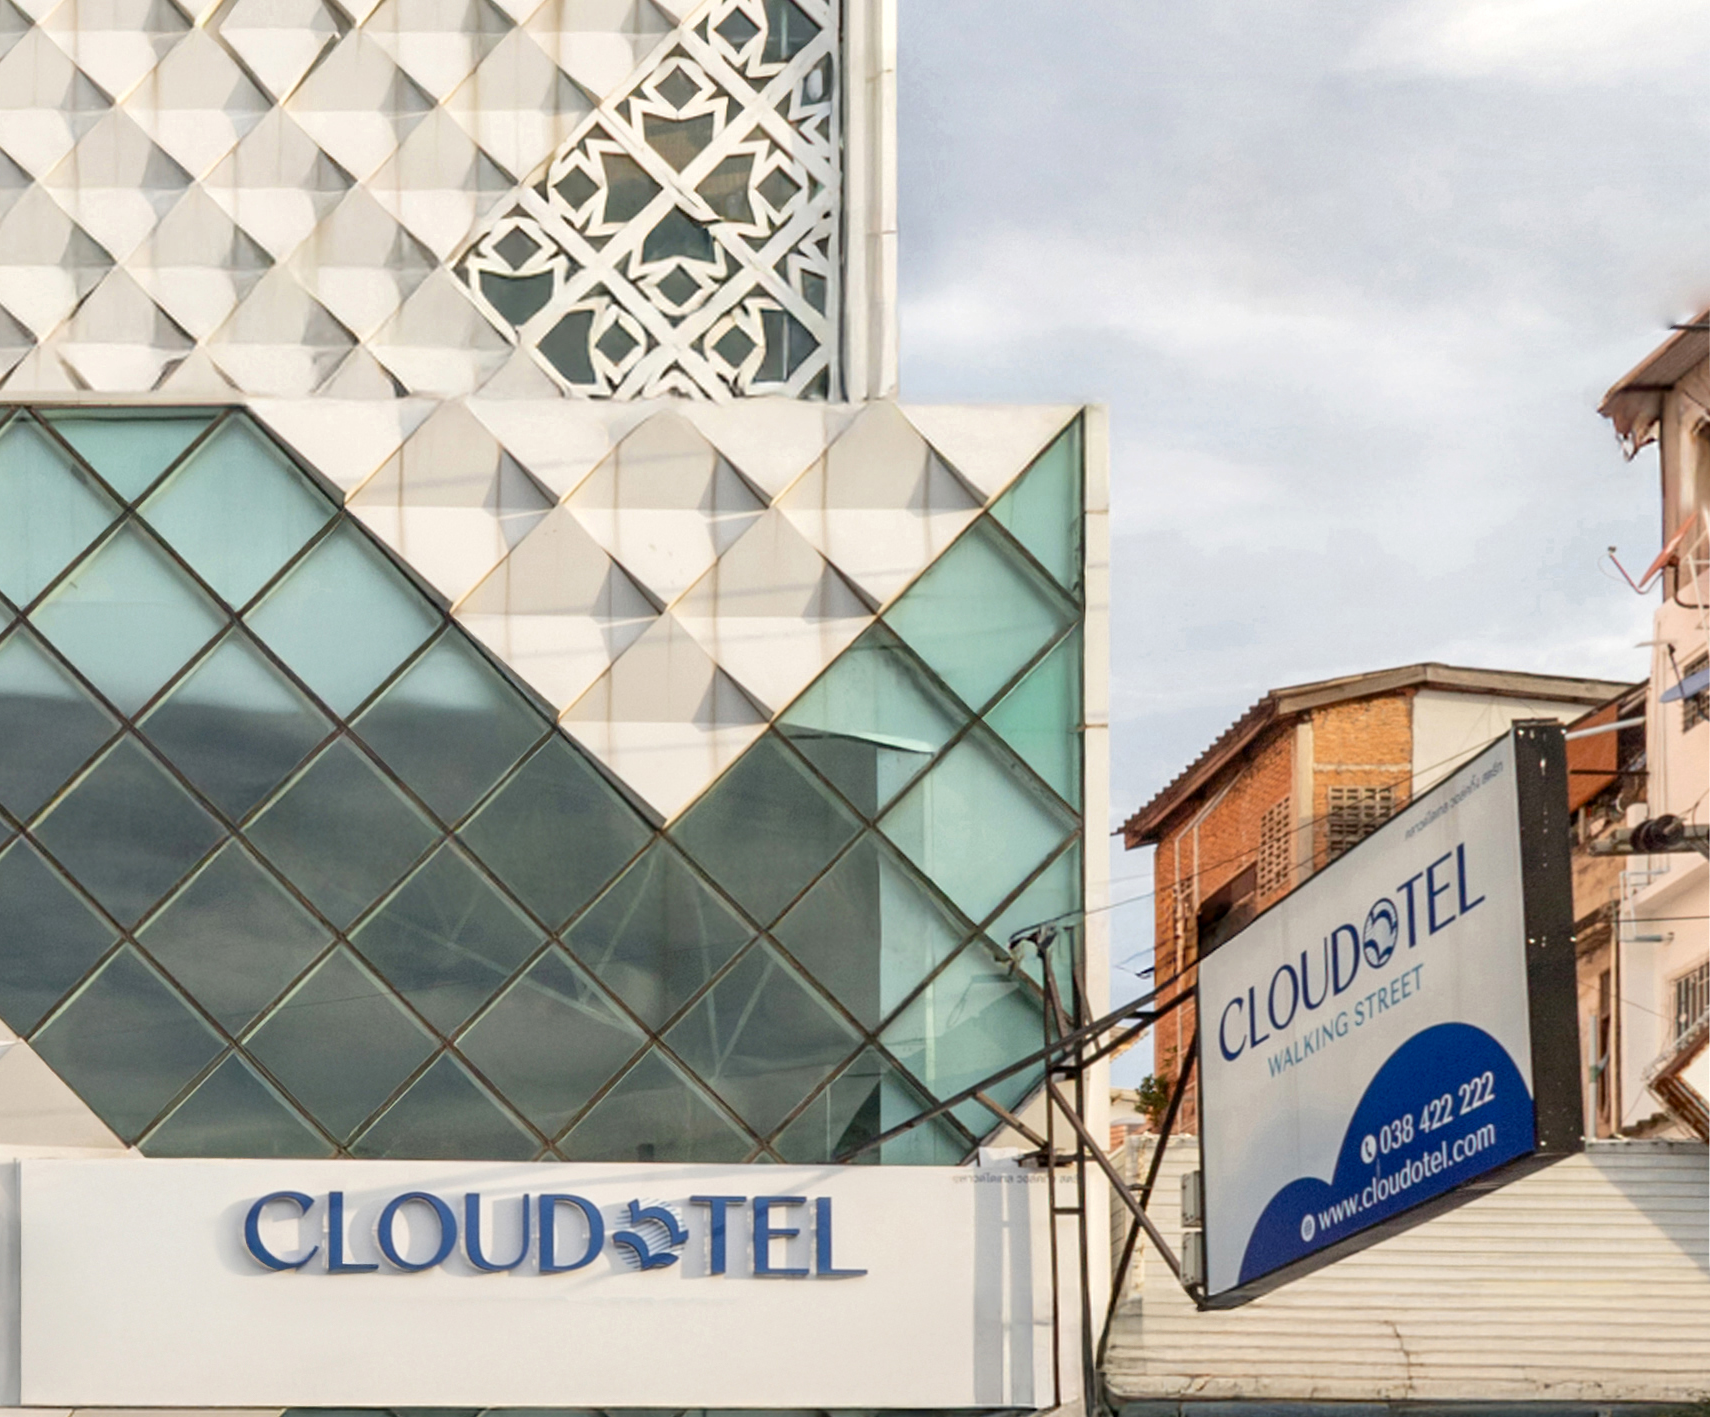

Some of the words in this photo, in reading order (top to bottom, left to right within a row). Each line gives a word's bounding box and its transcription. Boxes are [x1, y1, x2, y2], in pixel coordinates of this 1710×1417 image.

[1217, 842, 1486, 1062] CLOUDOTEL
[1267, 1011, 1349, 1078] WALKING
[1354, 963, 1425, 1026] STREET
[1379, 1113, 1414, 1155] 038
[1419, 1094, 1453, 1134] 422
[1458, 1071, 1496, 1115] 222
[1318, 1123, 1496, 1232] www.cloudotel.com
